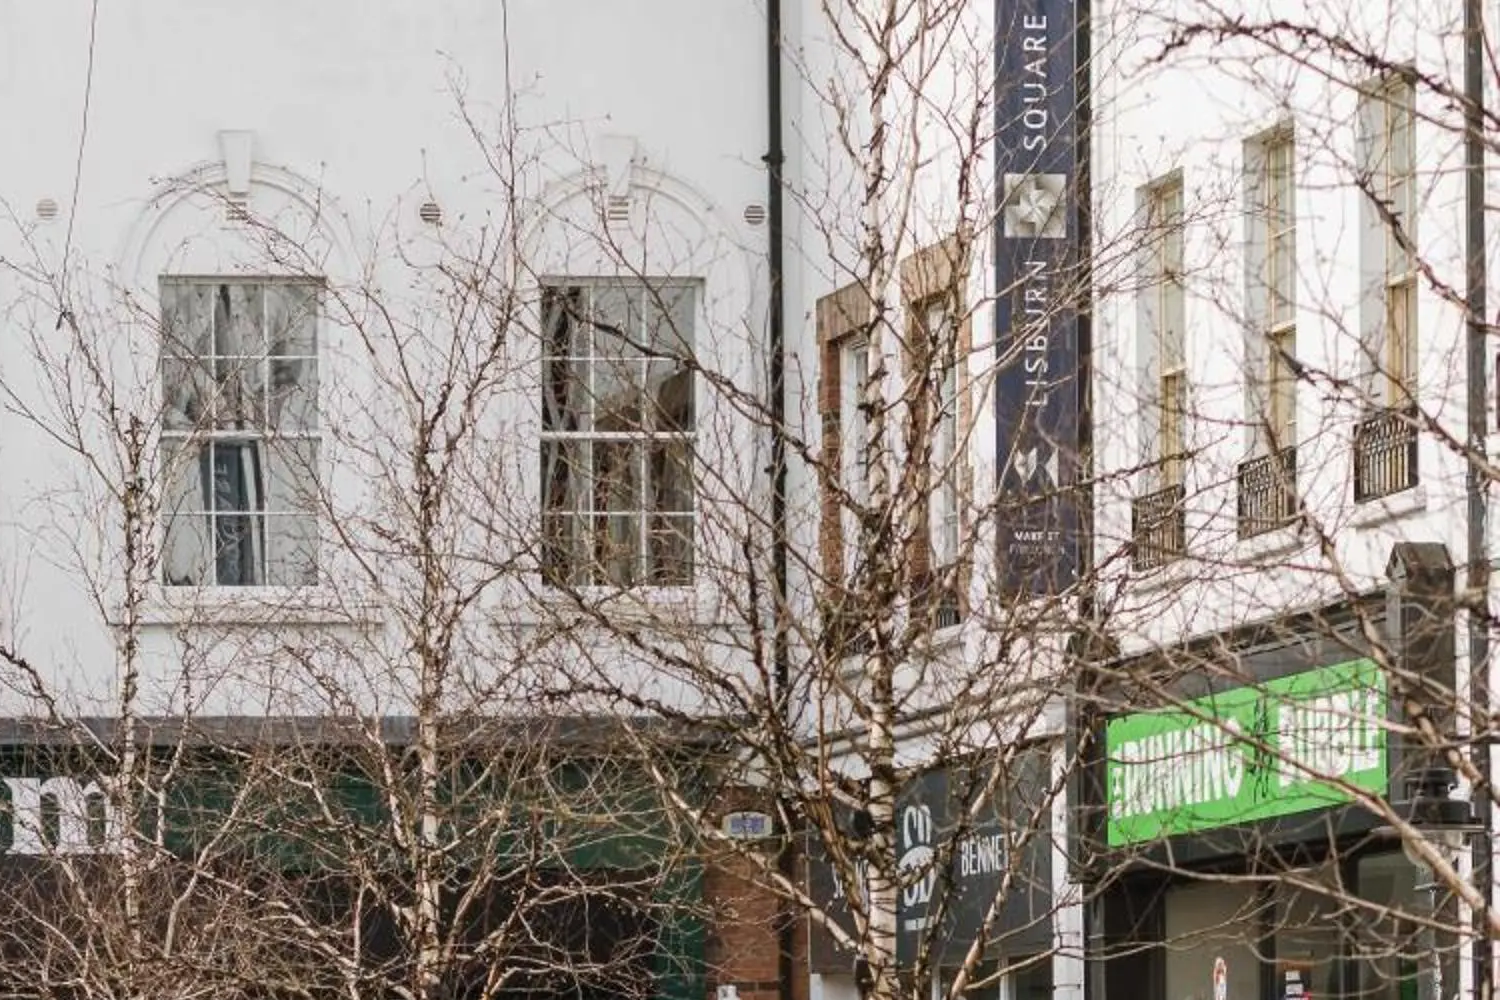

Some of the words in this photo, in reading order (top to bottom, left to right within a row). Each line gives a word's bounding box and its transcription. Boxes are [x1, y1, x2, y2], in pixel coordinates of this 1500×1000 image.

[1023, 15, 1047, 152] SQUARE
[1024, 261, 1048, 405] LISBURN
[1124, 717, 1243, 818] RUNNING
